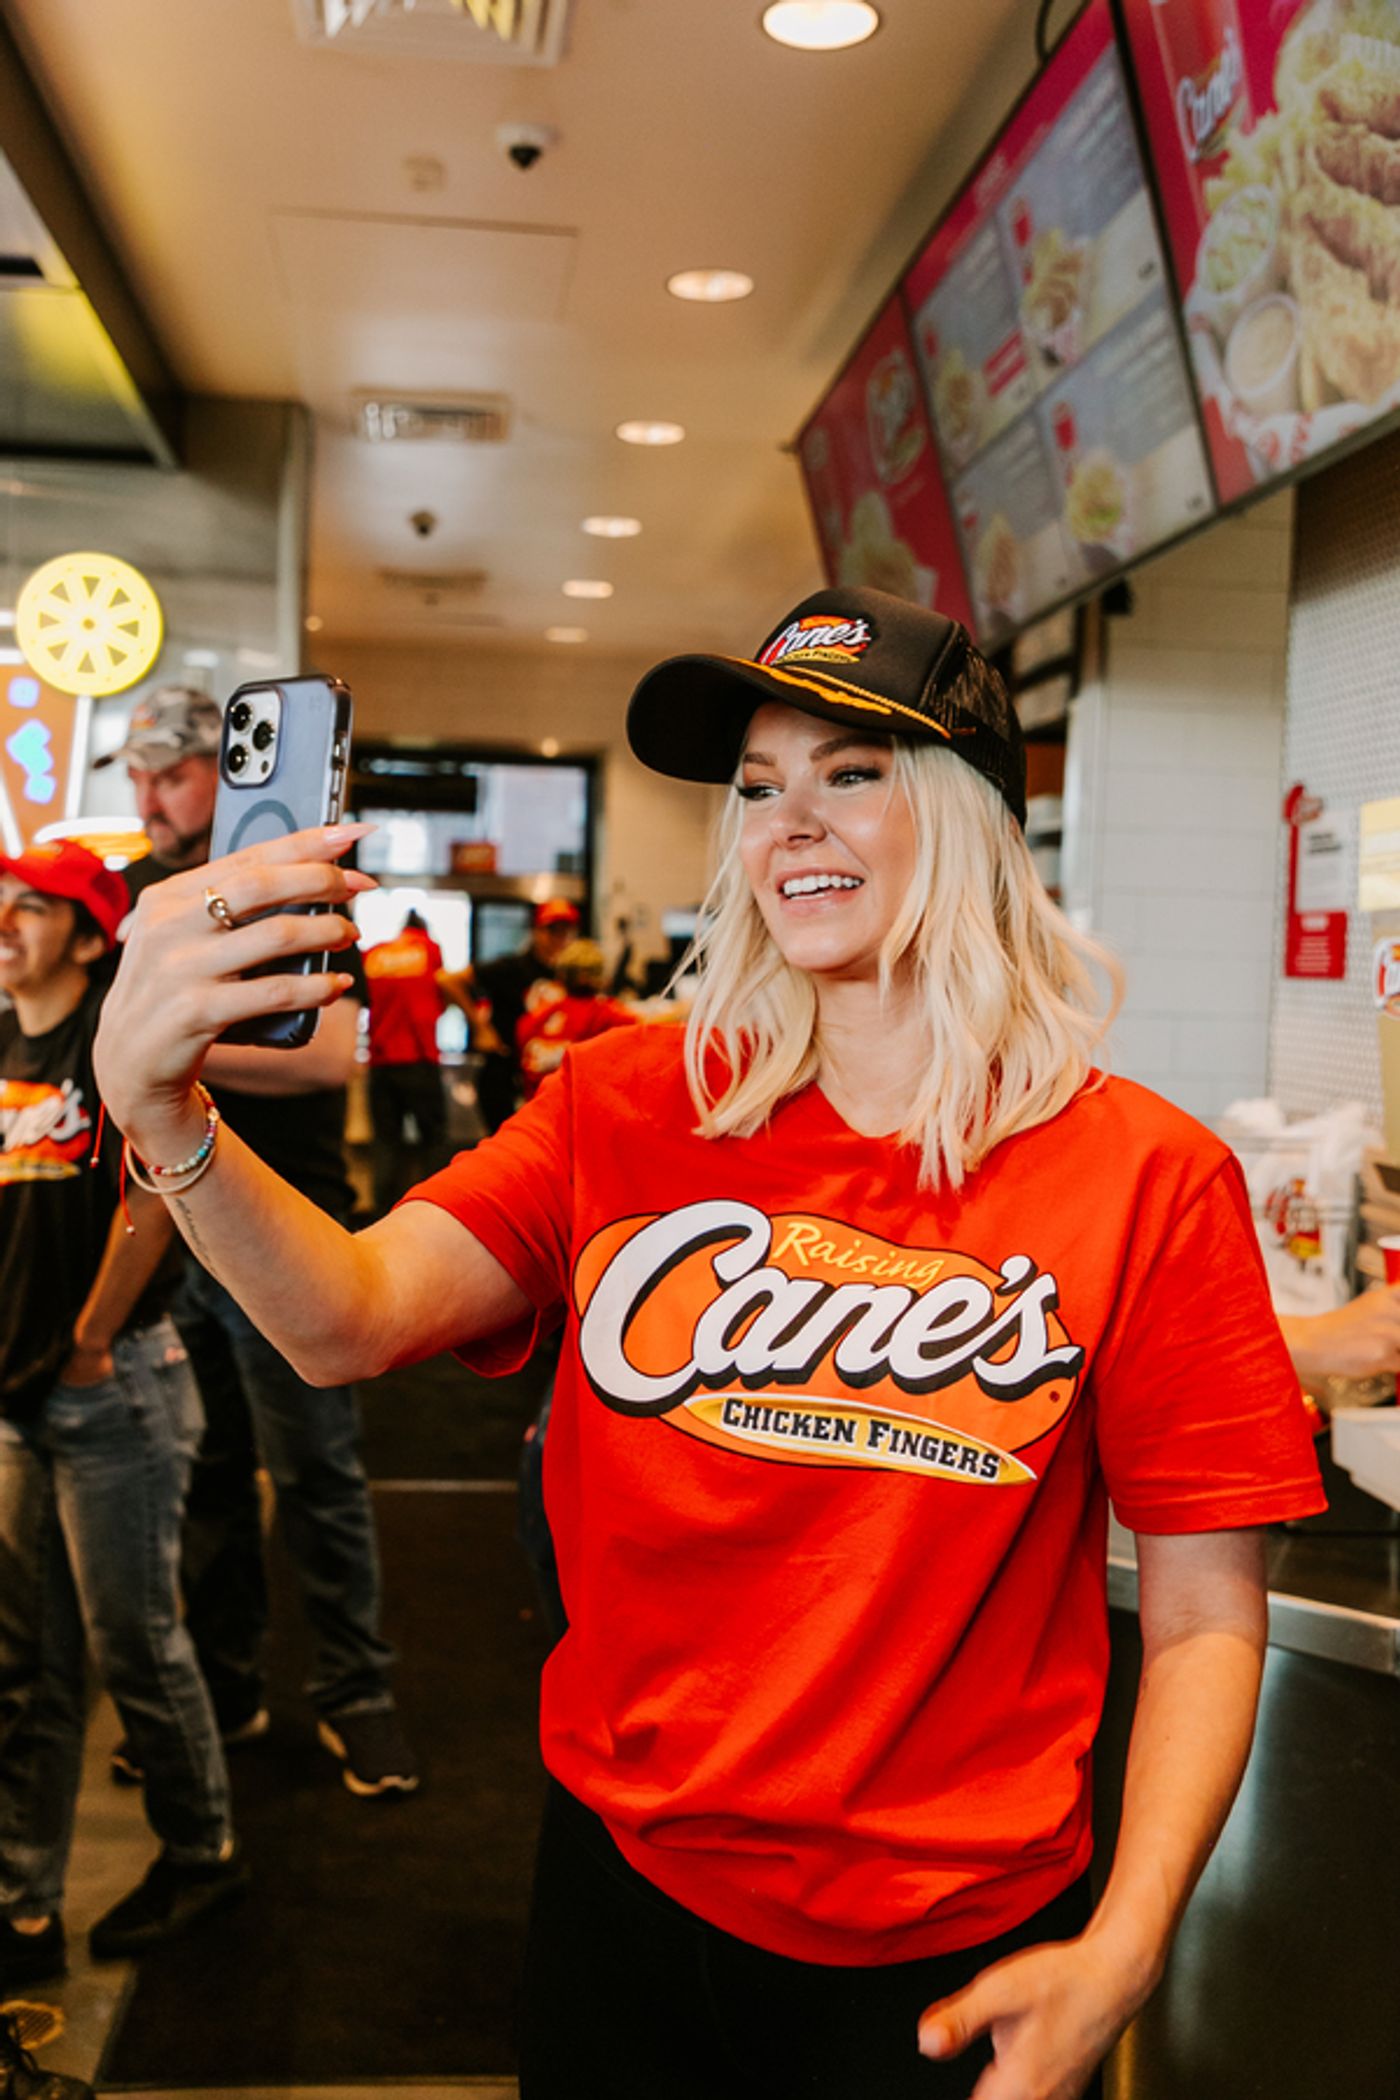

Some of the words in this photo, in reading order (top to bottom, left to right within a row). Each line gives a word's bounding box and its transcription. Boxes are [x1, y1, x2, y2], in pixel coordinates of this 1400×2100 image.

[771, 1221, 945, 1290] Raising
[580, 1199, 1085, 1417] Cane's
[722, 1397, 856, 1444] CHICKEN
[866, 1418, 1001, 1480] FINGERS
